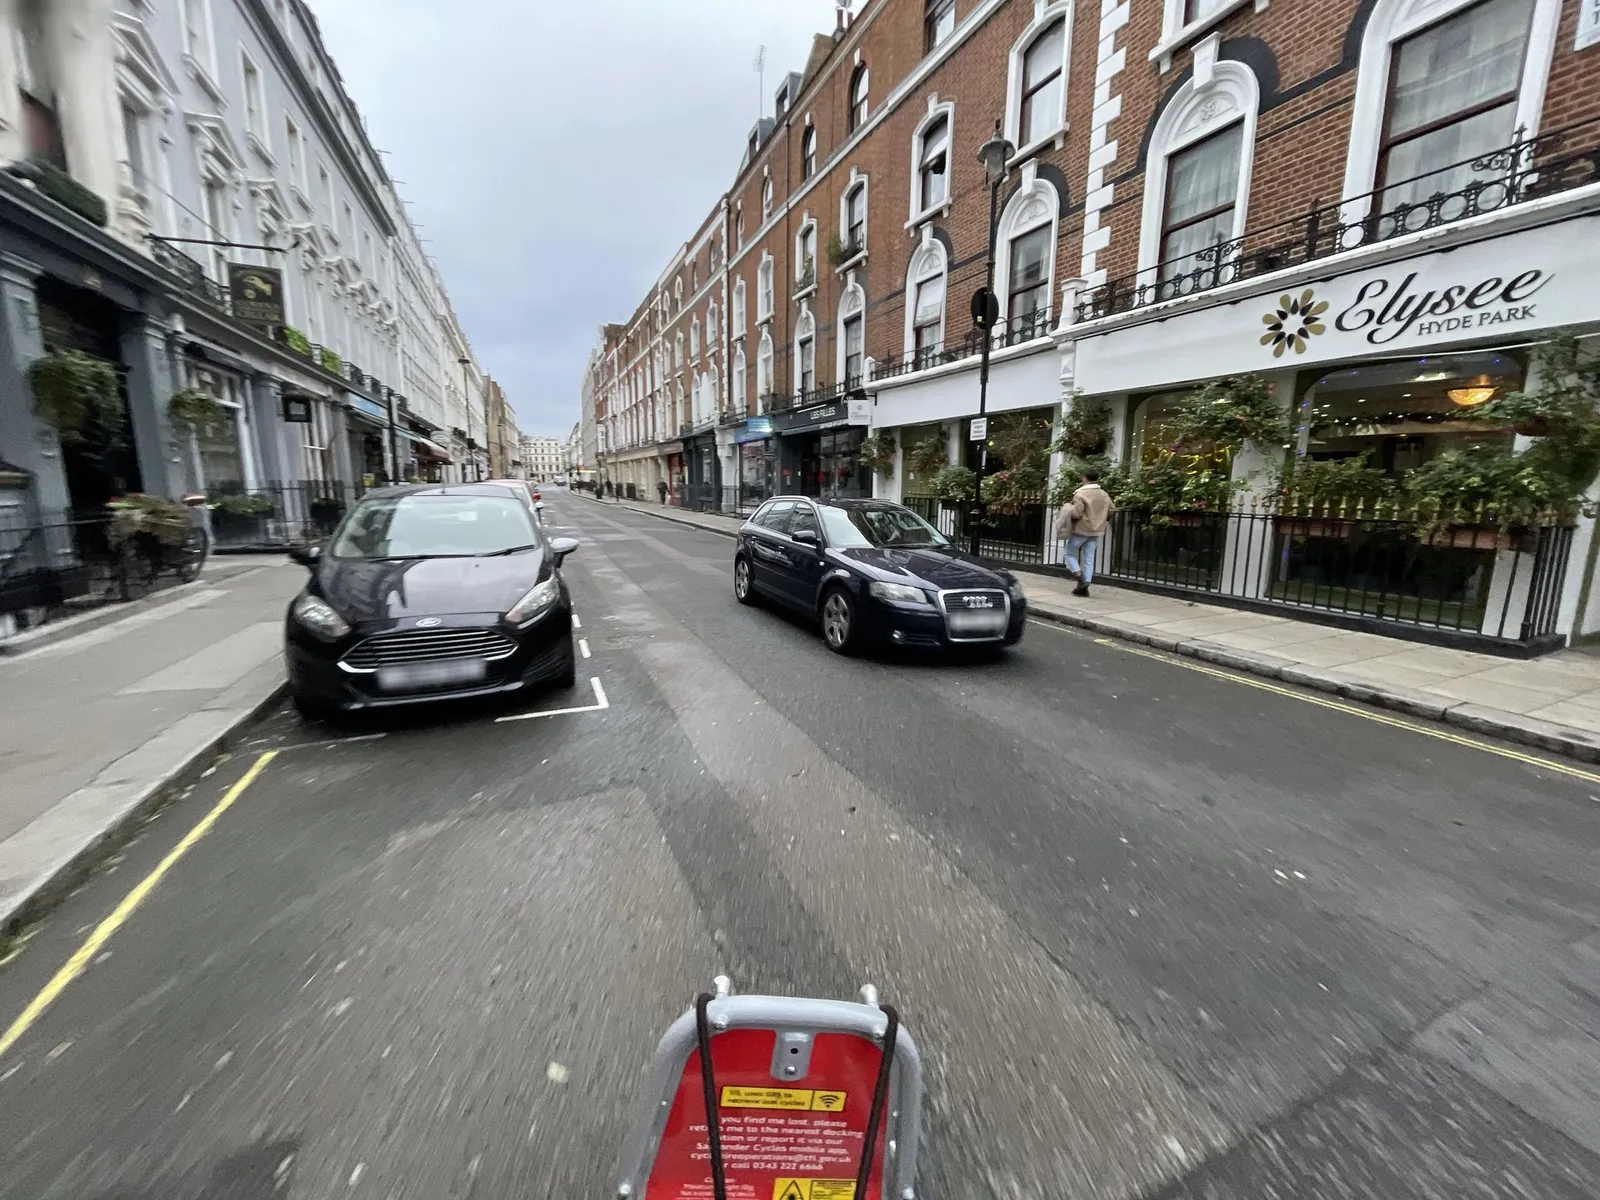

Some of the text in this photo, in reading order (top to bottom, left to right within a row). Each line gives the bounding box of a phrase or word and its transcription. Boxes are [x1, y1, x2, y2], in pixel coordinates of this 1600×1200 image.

[1335, 269, 1556, 345] Elysee
[1417, 304, 1537, 336] HYDE PARK
[810, 410, 819, 419] LES
[721, 1116, 741, 1124] you
[744, 1115, 766, 1124] find
[767, 1117, 785, 1125] me
[813, 1119, 848, 1128] please
[746, 1125, 758, 1133] to
[781, 1127, 821, 1135] nearest
[822, 1128, 864, 1138] docking
[760, 1136, 795, 1144] report
[753, 1144, 787, 1153] Cycles
[789, 1145, 825, 1153] mobile
[731, 1161, 750, 1169] call
[752, 1161, 778, 1170] 0343
[780, 1162, 797, 1170] 222
[799, 1163, 824, 1171] 6666
